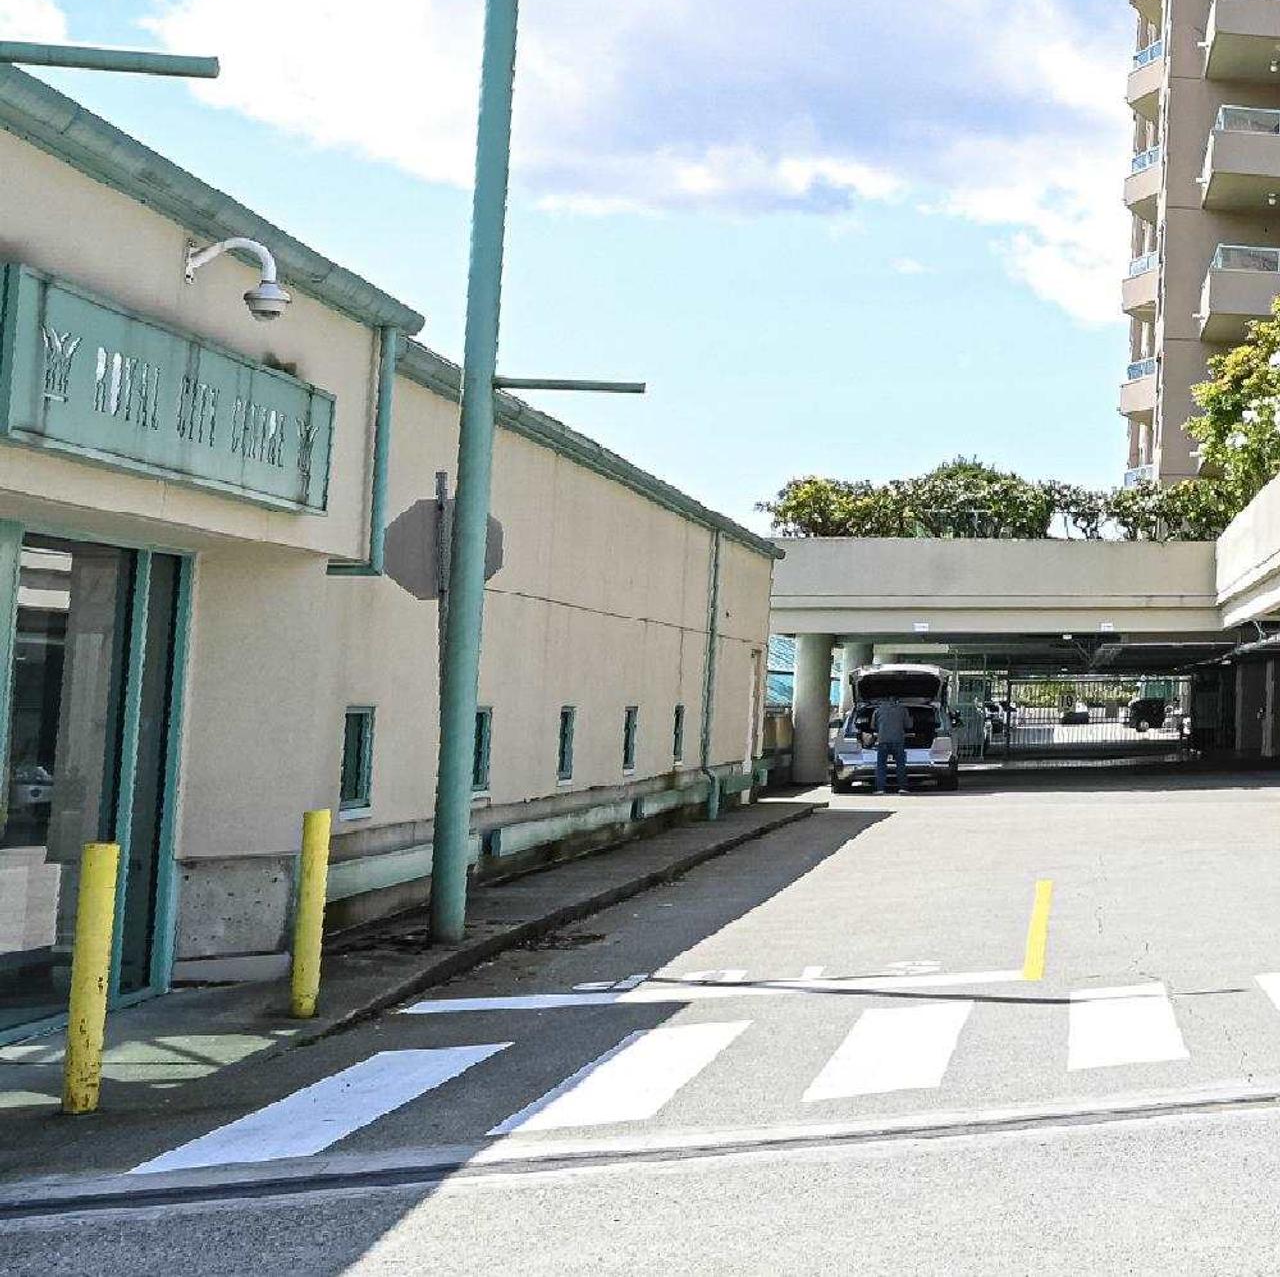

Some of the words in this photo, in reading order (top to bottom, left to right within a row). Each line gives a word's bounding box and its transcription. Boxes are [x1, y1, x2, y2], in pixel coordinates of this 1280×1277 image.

[93, 346, 161, 431] ROYAL
[177, 374, 221, 448] CITY
[231, 396, 287, 468] CENTRE
